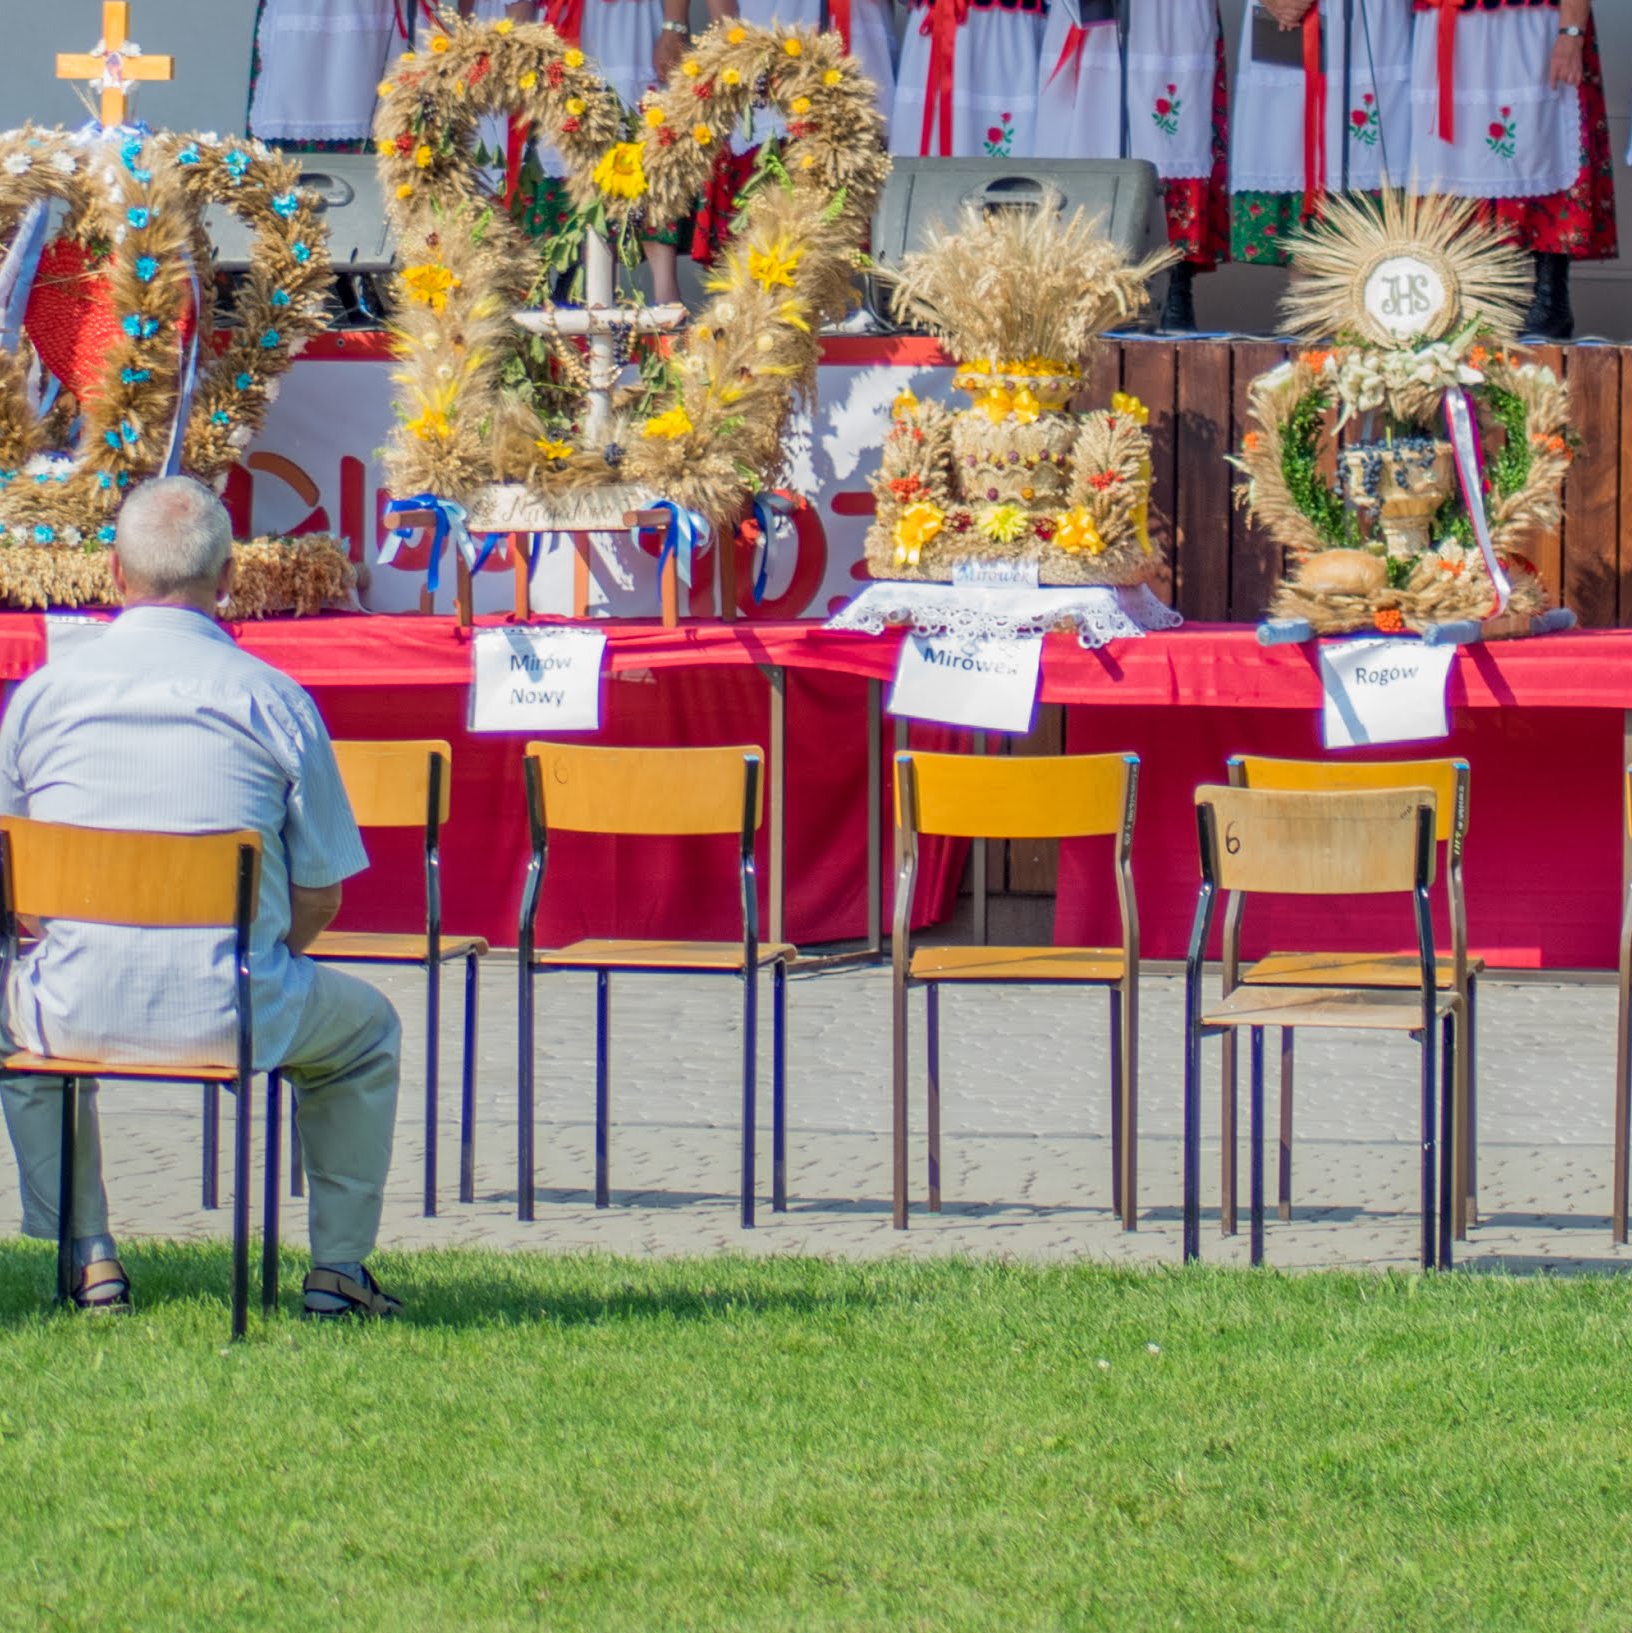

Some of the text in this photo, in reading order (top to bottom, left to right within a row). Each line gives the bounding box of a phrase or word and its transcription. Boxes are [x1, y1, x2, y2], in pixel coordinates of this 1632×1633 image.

[510, 653, 573, 672] Mirów
[1355, 664, 1419, 686] Rogów
[510, 688, 565, 707] Nowy
